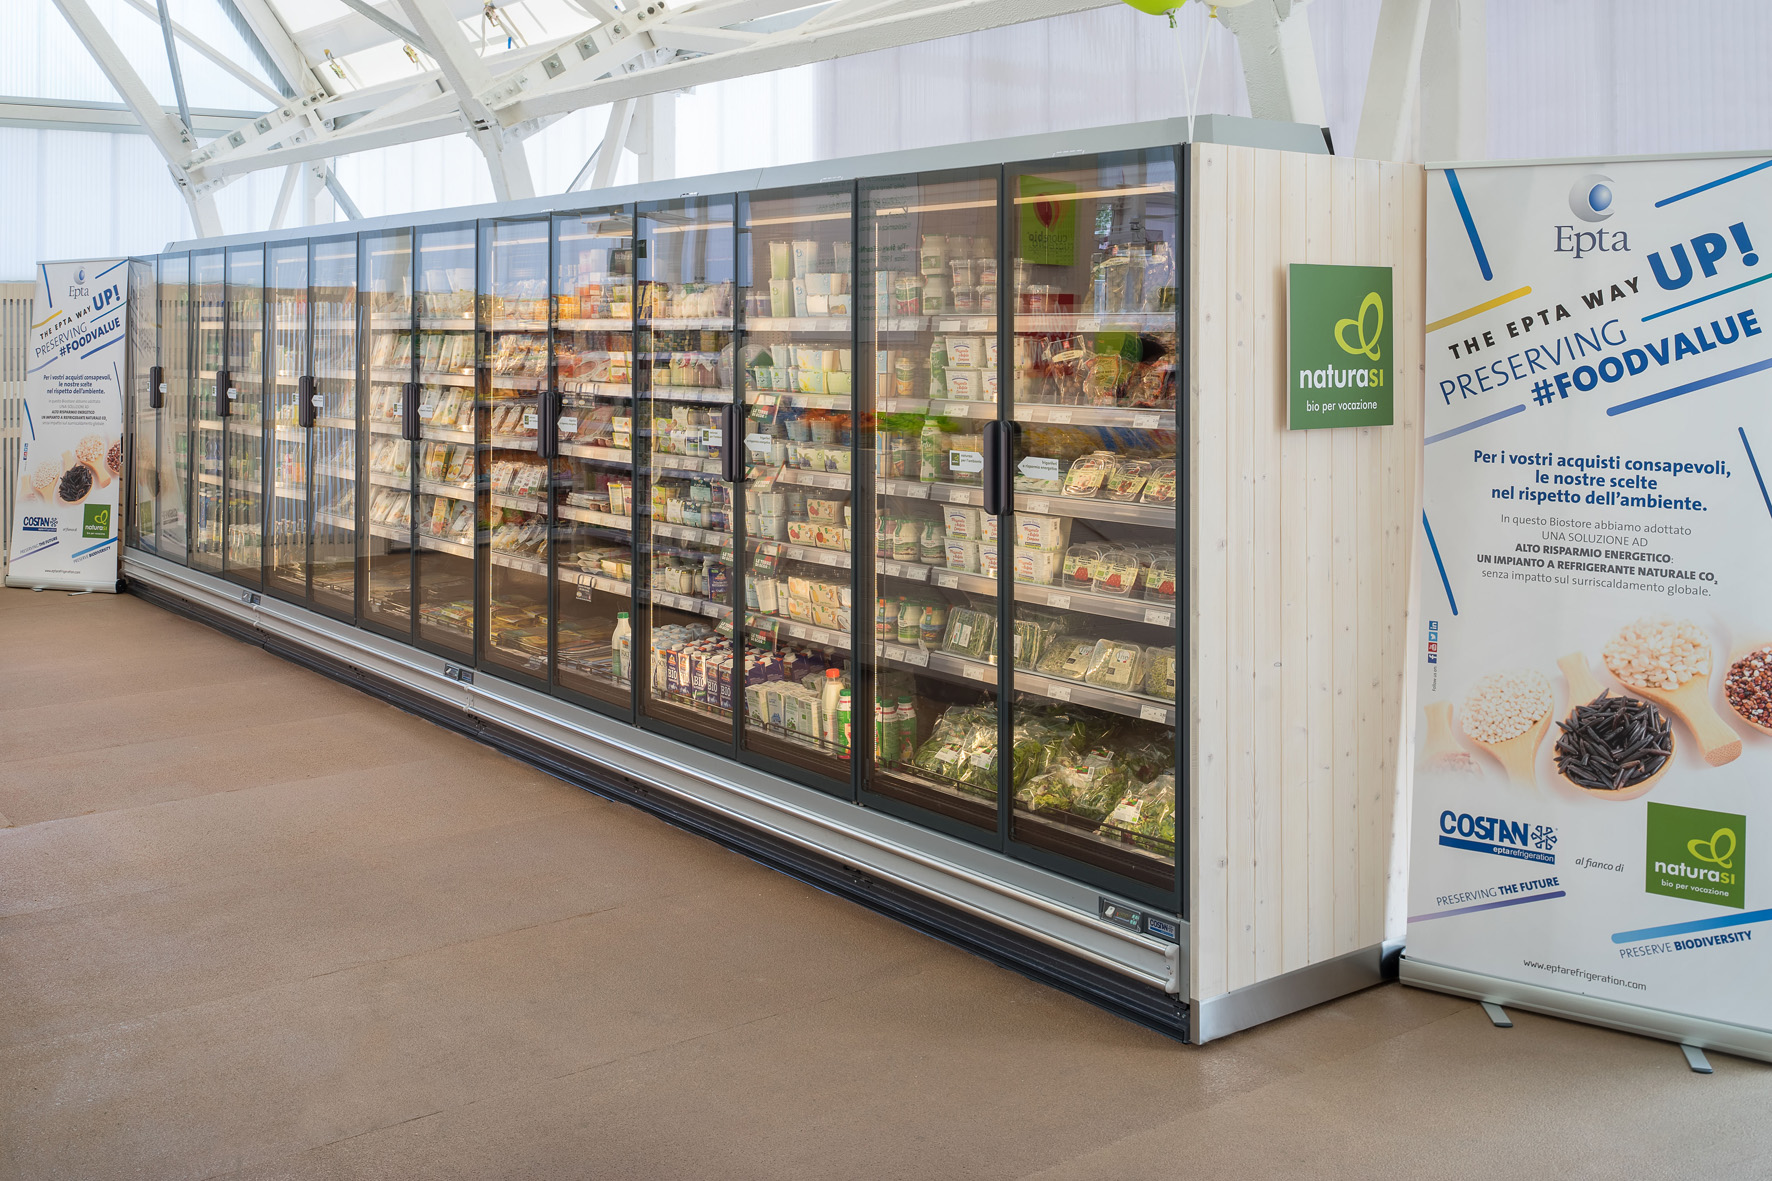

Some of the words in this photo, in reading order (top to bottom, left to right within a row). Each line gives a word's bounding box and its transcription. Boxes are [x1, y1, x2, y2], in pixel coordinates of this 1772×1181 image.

[1554, 225, 1632, 259] Epta
[69, 286, 89, 299] Epta
[1448, 330, 1496, 360] THE
[1506, 304, 1571, 339] EPTA
[1581, 276, 1640, 310] WAY
[1646, 221, 1760, 291] UP!
[40, 328, 52, 339] THE
[55, 316, 72, 330] EPTA
[75, 306, 91, 318] WAY
[93, 284, 120, 311] UP!
[35, 322, 87, 358] PRESERVING
[60, 317, 120, 356] #FOODVALUE
[1439, 318, 1628, 406] PRESERVING
[1530, 308, 1763, 407] #FOODVALUE
[1307, 400, 1319, 412] bio
[1322, 402, 1336, 414] per
[1338, 399, 1378, 411] vocazione
[1474, 450, 1496, 463] Per
[1500, 451, 1505, 464] i
[1509, 452, 1552, 466] vostri
[1556, 455, 1620, 472] acquisti
[1624, 458, 1732, 479] consapevoli,
[1535, 470, 1549, 484] le
[1554, 473, 1606, 487] nostre
[1610, 474, 1658, 490] scelte
[1492, 486, 1514, 500] nel
[1518, 488, 1581, 506] rispetto
[24, 517, 50, 526] COSTAN
[1500, 514, 1510, 524] In
[1512, 516, 1547, 529] questo
[1549, 517, 1592, 530] Biostore
[1594, 518, 1642, 533] abbiamo
[1644, 522, 1692, 536] adottato
[1542, 530, 1566, 542] UNA
[1568, 532, 1630, 546] SOLUZIONE
[1632, 536, 1648, 547] AD
[1515, 543, 1541, 554] ALTO
[1543, 545, 1602, 558] RISPARMIO
[1605, 549, 1674, 564] ENERGETICO:
[1476, 554, 1492, 564] UN
[1494, 555, 1545, 568] IMPIANTO
[1547, 559, 1555, 569] A
[1557, 559, 1635, 575] REFRIGERANTE
[1638, 565, 1696, 581] NATURALE
[1482, 570, 1509, 580] senza
[1512, 570, 1552, 586] impatto
[1554, 574, 1569, 585] sul
[1572, 576, 1665, 593] surriscaldamento
[1667, 583, 1711, 597] globale.
[1440, 810, 1529, 846] COSTAN
[1493, 846, 1554, 863] eptarefrigeration
[1575, 857, 1584, 866] al
[1584, 858, 1612, 871] fianco
[1614, 862, 1624, 872] di
[1436, 886, 1497, 906] PRESERVING
[1498, 884, 1518, 896] THE
[1520, 876, 1560, 894] FUTURE
[1661, 879, 1674, 888] bio
[1676, 882, 1688, 892] per
[1690, 884, 1729, 897] vocazione
[1150, 919, 1168, 930] COSTAN
[1619, 942, 1672, 959] PRESERVE
[1674, 930, 1752, 952] BIODIVERSITY
[1523, 958, 1647, 991] www.eptarefrigeration.com
